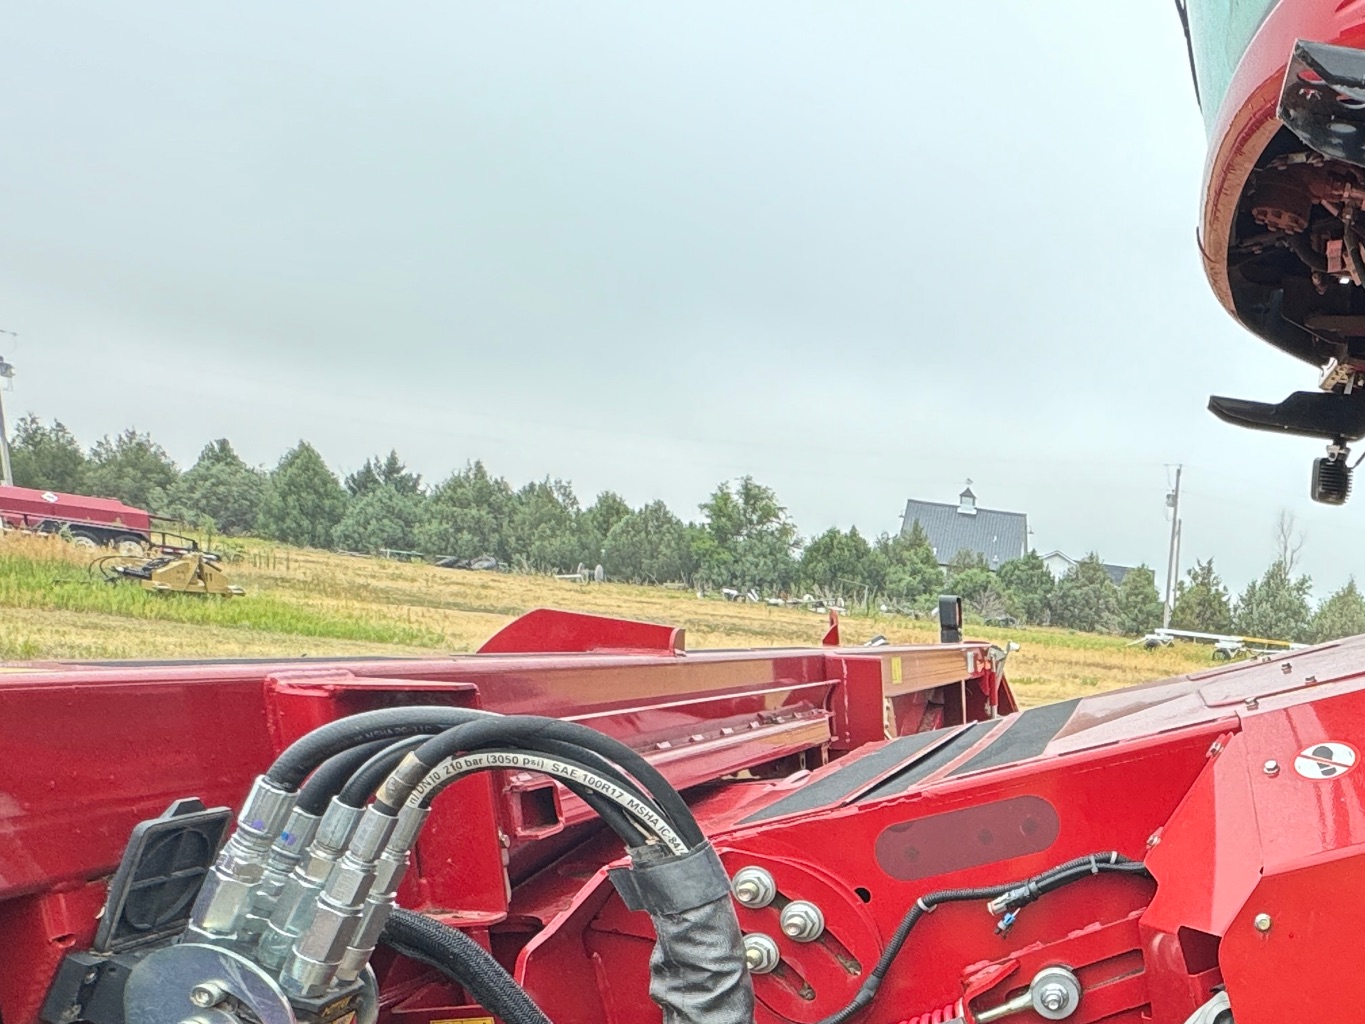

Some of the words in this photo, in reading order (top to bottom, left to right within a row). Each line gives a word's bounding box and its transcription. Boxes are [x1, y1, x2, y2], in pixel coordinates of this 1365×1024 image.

[415, 771, 441, 795] DN10
[443, 760, 463, 775] 210
[465, 756, 483, 768] bar
[486, 754, 519, 765] (3050
[522, 757, 545, 769] psi)
[551, 763, 578, 779] SAE
[582, 772, 624, 800] 100R17
[627, 798, 660, 828] MSHA
[658, 825, 687, 853] IC-84/
